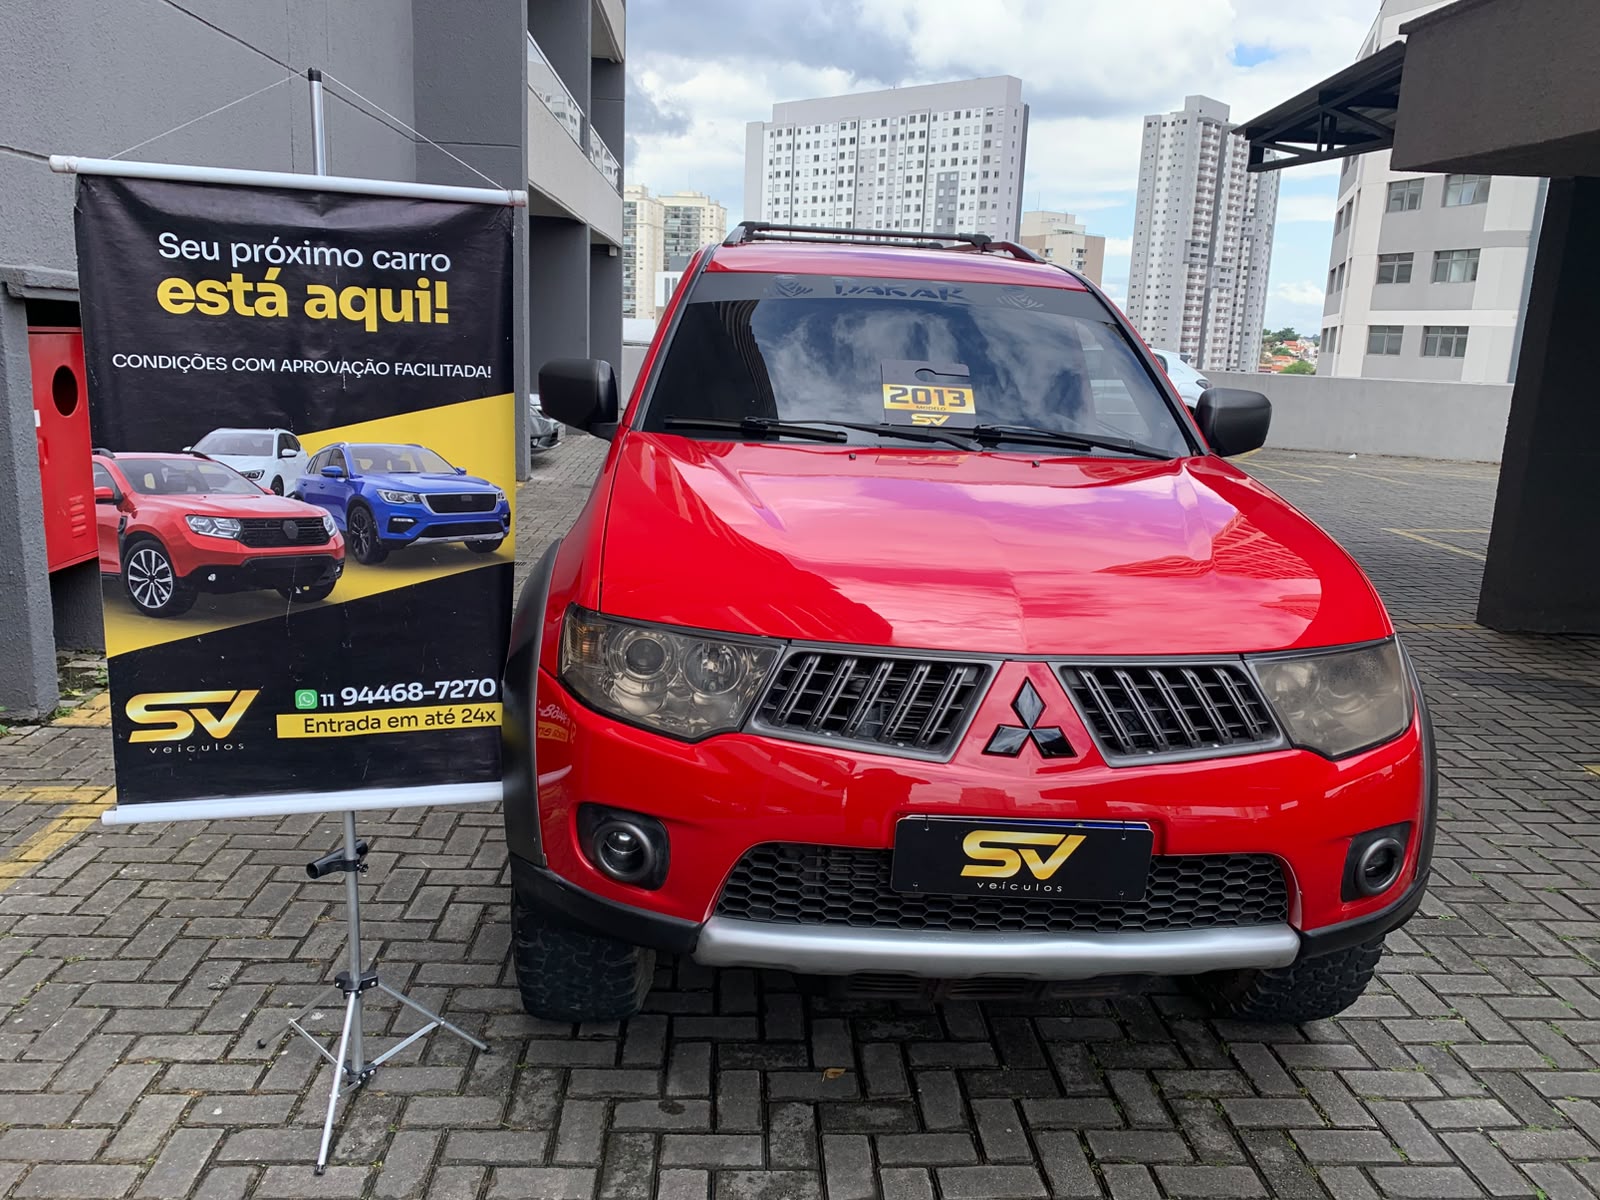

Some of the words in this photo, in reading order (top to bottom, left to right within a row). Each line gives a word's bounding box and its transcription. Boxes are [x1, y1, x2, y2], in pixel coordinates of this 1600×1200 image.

[158, 231, 220, 261] Seu
[231, 236, 364, 268] próximo
[372, 250, 451, 272] carro
[156, 267, 289, 318] está
[304, 277, 449, 332] aqui!
[112, 353, 227, 374] CONDIÇÕES
[231, 357, 275, 372] COM
[280, 357, 390, 378] APROVAÇÃO
[394, 362, 492, 379] FACILITADA!
[889, 386, 966, 407] 2013
[911, 413, 950, 426] SV
[320, 693, 335, 707] 11
[340, 678, 497, 706] 94468-7270
[125, 689, 260, 743] SV
[304, 715, 381, 734] Entrada
[387, 714, 418, 729] em
[424, 707, 456, 726] até
[461, 707, 497, 724] 24x
[960, 829, 1087, 881] SV
[976, 881, 1063, 893] veículos
